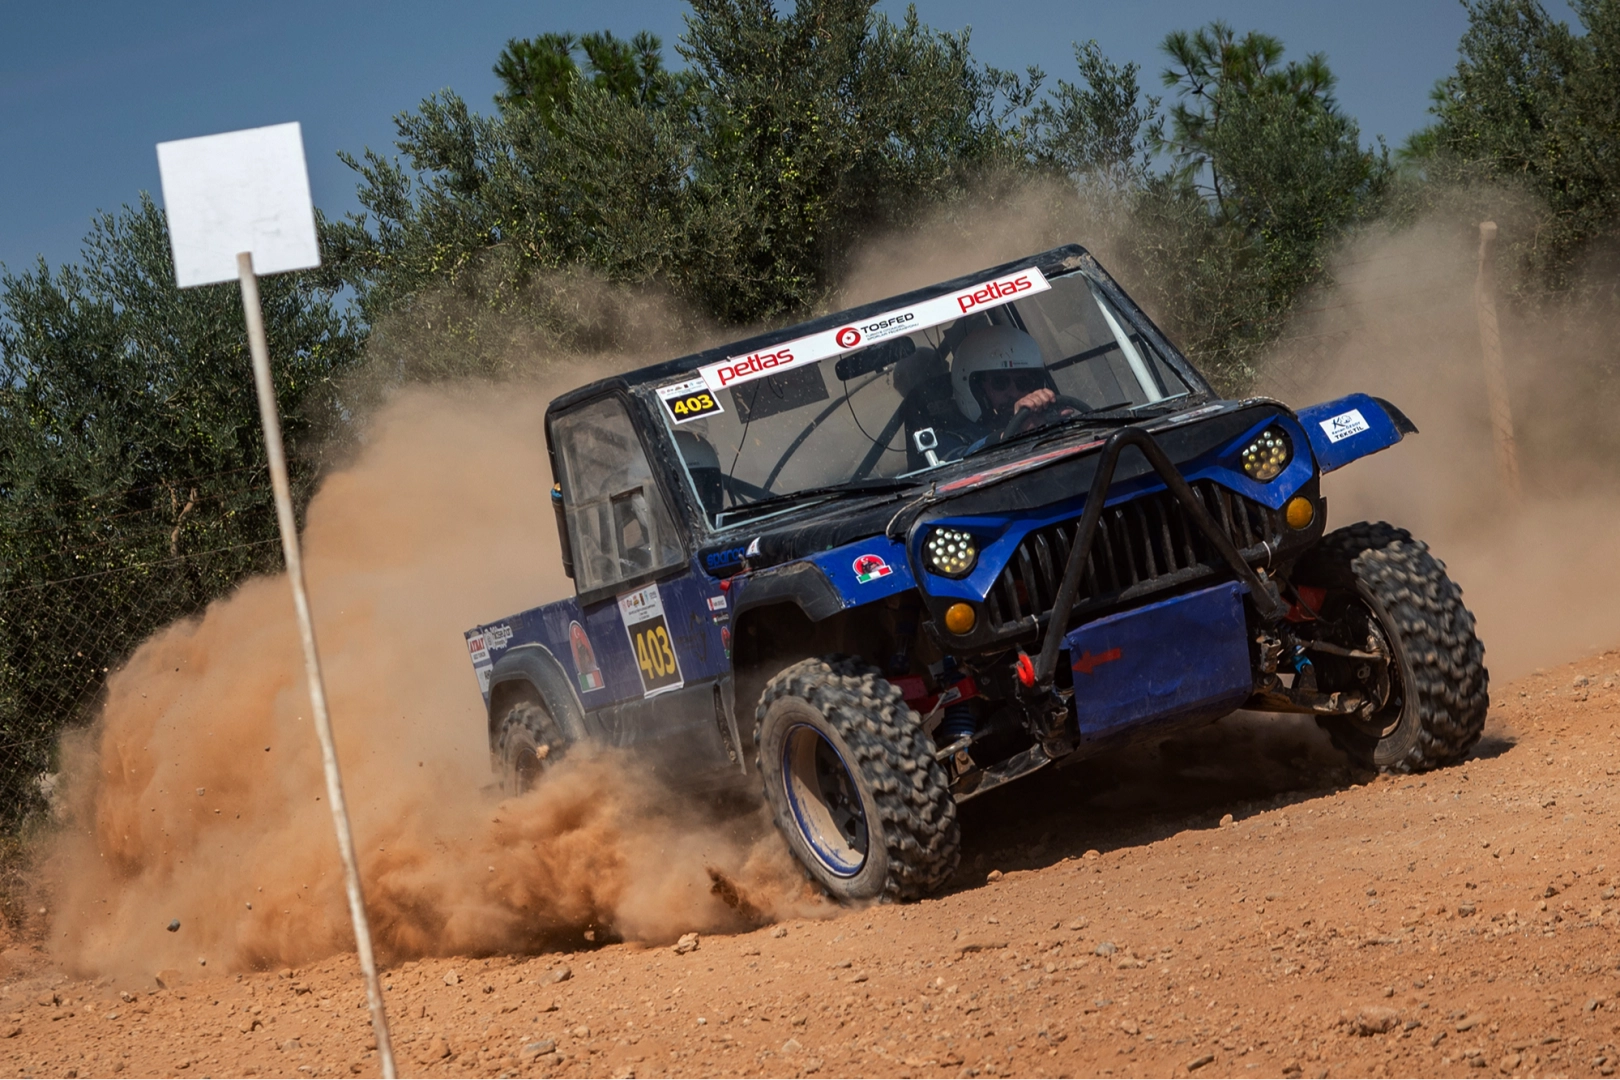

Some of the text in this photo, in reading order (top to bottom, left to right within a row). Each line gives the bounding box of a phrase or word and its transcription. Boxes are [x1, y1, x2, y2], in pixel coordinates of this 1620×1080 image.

[957, 275, 1032, 313] petlas
[861, 313, 914, 333] TOSFED
[717, 348, 794, 386] petlas
[674, 393, 714, 415] 403
[707, 547, 745, 566] sparco
[636, 626, 676, 679] 403
